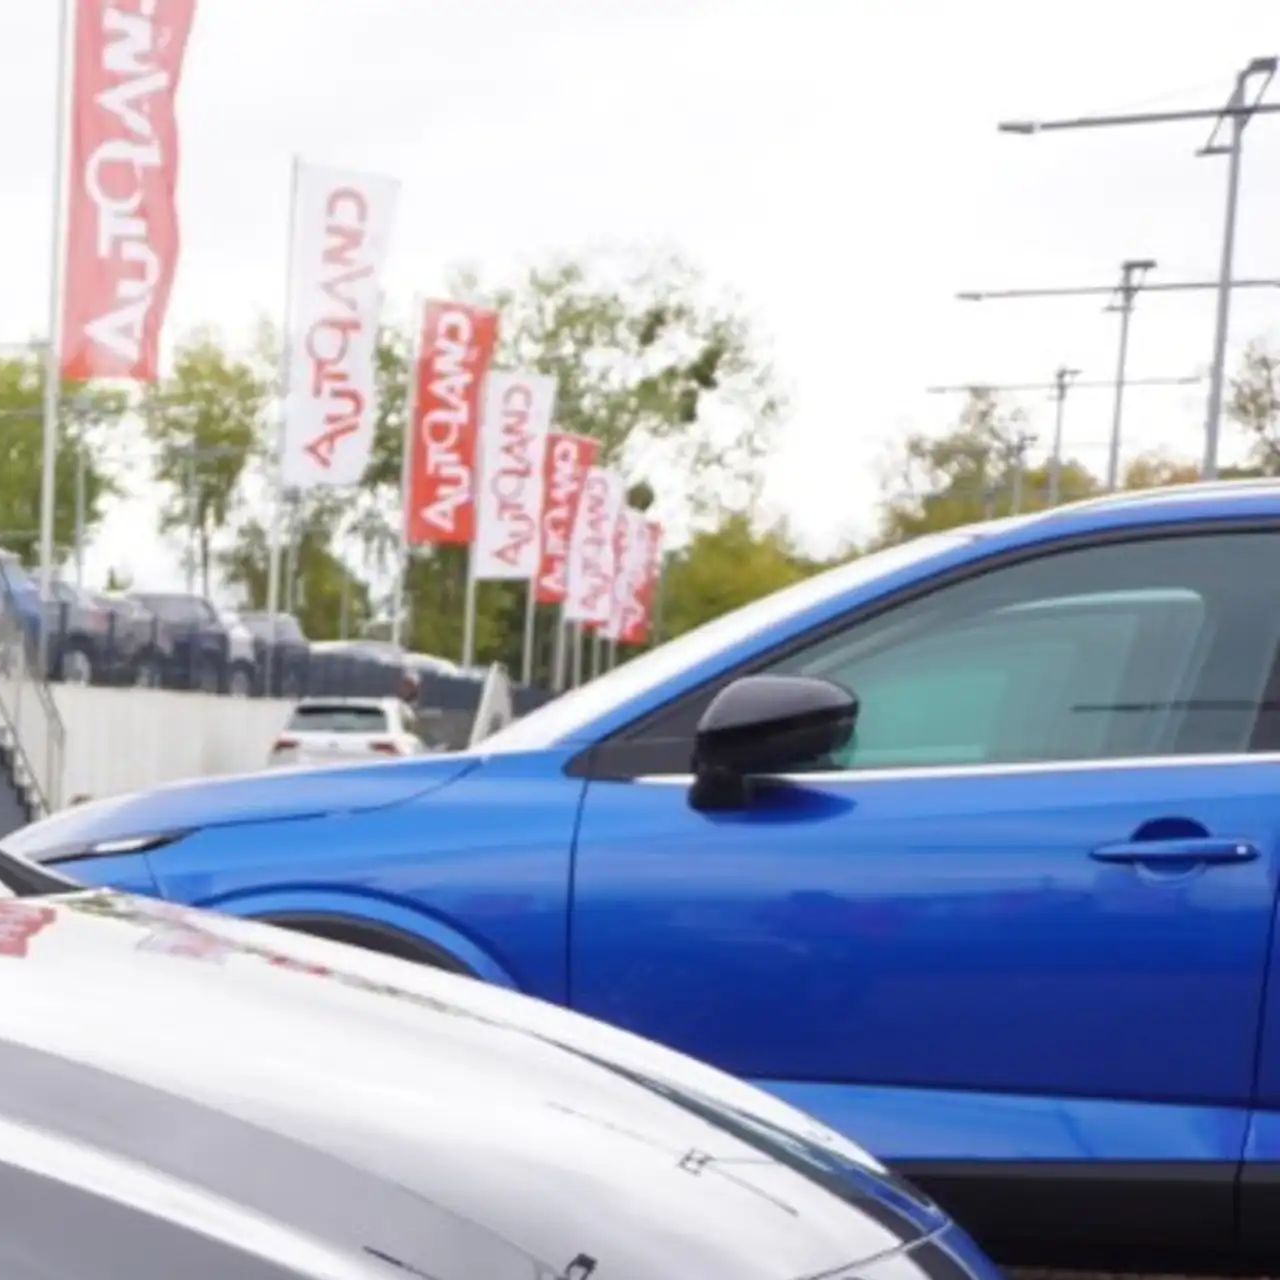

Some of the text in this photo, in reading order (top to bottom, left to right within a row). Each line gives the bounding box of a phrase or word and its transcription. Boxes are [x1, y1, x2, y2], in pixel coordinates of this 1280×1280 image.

[84, 0, 169, 362] AUTOLAN
[304, 186, 375, 469] AUTOLAND
[419, 309, 474, 534] AUTOLAND
[492, 383, 536, 567] AUTOLAND
